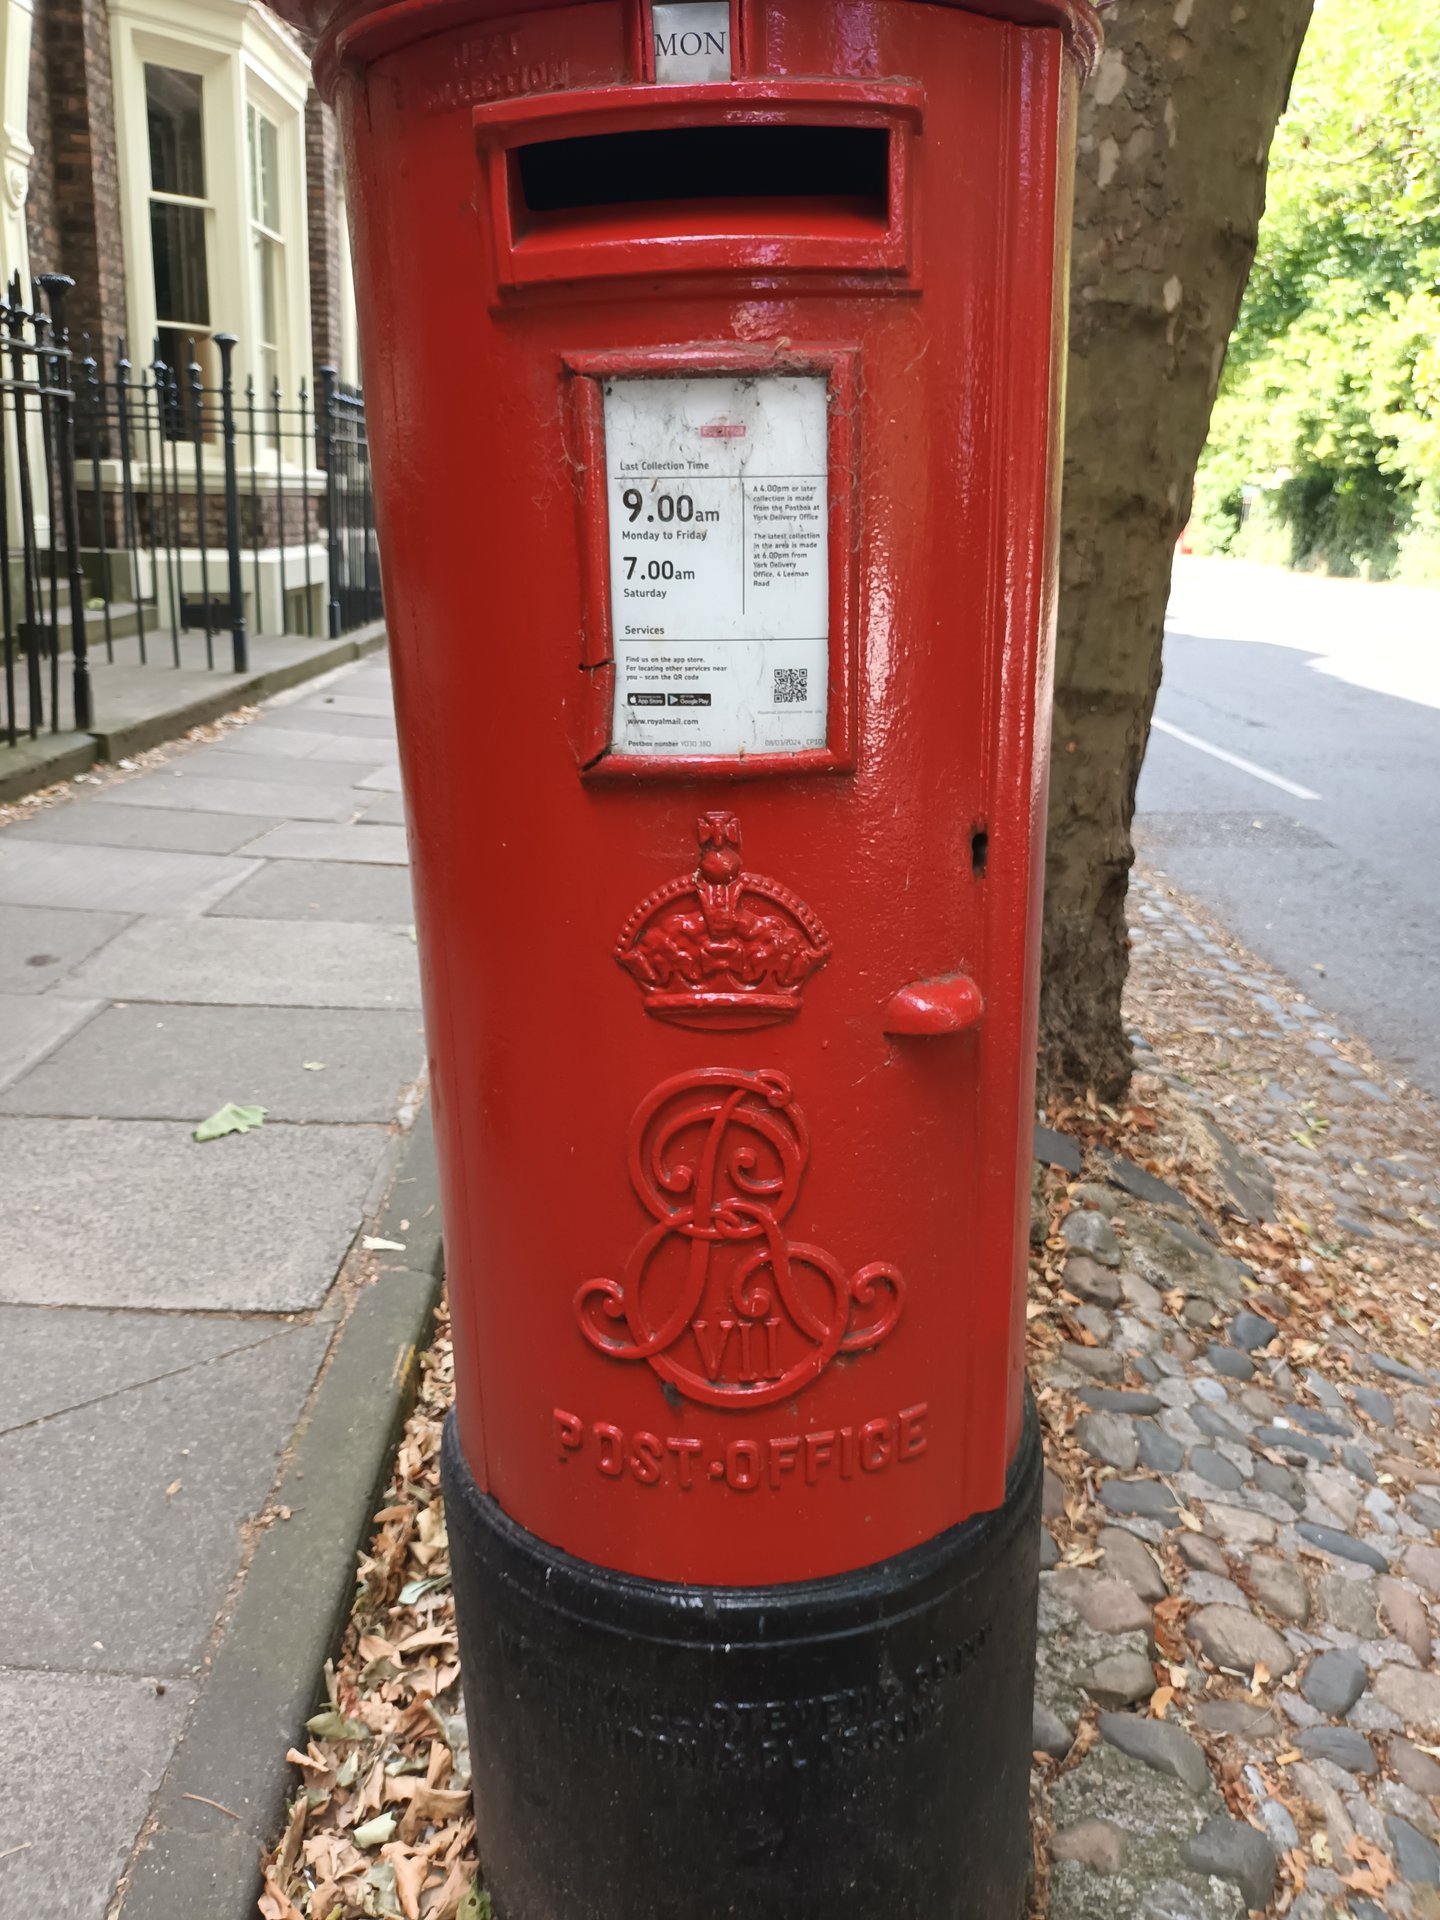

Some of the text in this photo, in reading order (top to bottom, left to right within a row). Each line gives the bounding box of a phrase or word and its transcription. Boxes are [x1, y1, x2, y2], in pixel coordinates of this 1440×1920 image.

[654, 30, 727, 57] MON
[620, 461, 709, 471] Last Collection Time
[760, 484, 789, 493] 4.00pm
[753, 494, 785, 502] collection
[623, 488, 720, 523] 9.00am
[753, 504, 770, 512] from
[772, 504, 782, 512] the
[753, 513, 767, 521] York
[770, 514, 797, 522] Delivery
[623, 530, 707, 542] Monday to Friday
[754, 532, 766, 540] The
[768, 532, 787, 540] latest
[762, 551, 789, 561] 6.00pm
[623, 557, 695, 580] 7.00am
[753, 561, 796, 569] York Delivery
[624, 589, 667, 599] Saturday
[625, 626, 664, 635] Services
[638, 665, 664, 673] locating
[638, 698, 650, 706] App
[680, 698, 709, 706] Google Play
[627, 717, 698, 726] www.royalmail.com
[693, 1318, 780, 1382] VII
